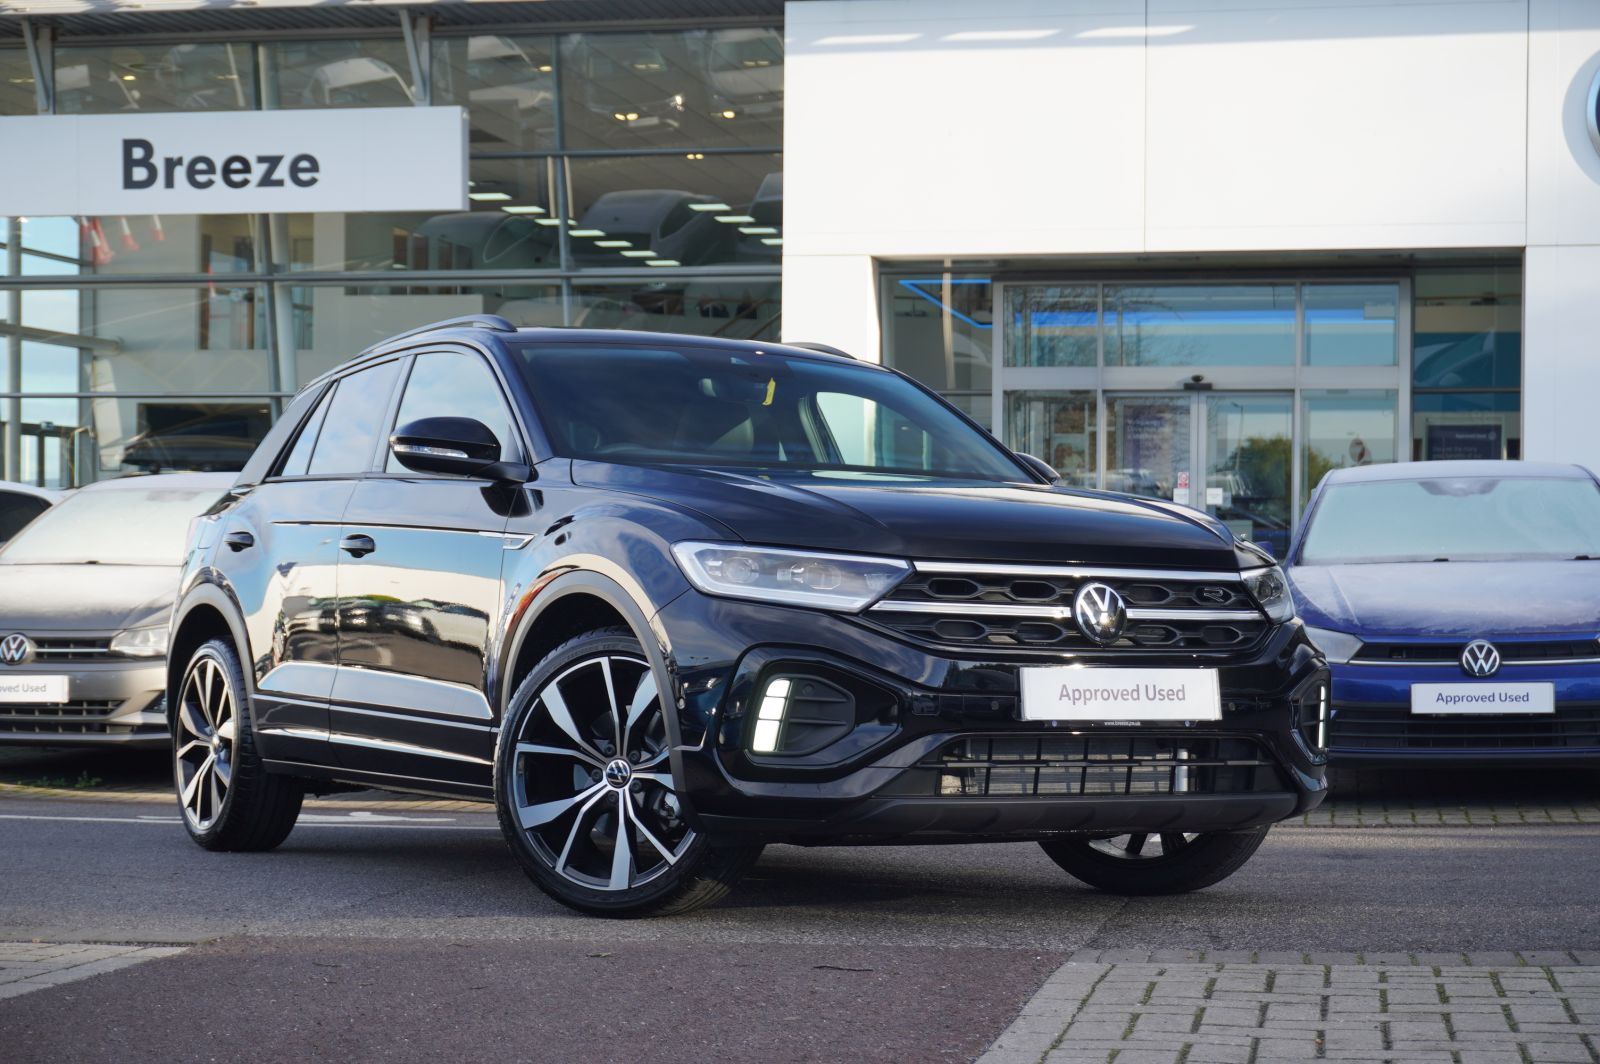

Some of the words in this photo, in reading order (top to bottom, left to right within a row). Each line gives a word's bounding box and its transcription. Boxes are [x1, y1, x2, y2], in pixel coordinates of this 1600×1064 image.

[122, 138, 320, 189] Breeze
[1462, 641, 1500, 674] VW
[22, 683, 47, 693] Used
[1058, 684, 1141, 706] Approved
[1144, 684, 1186, 702] Used
[1436, 692, 1496, 706] Approved
[1498, 691, 1530, 703] Used
